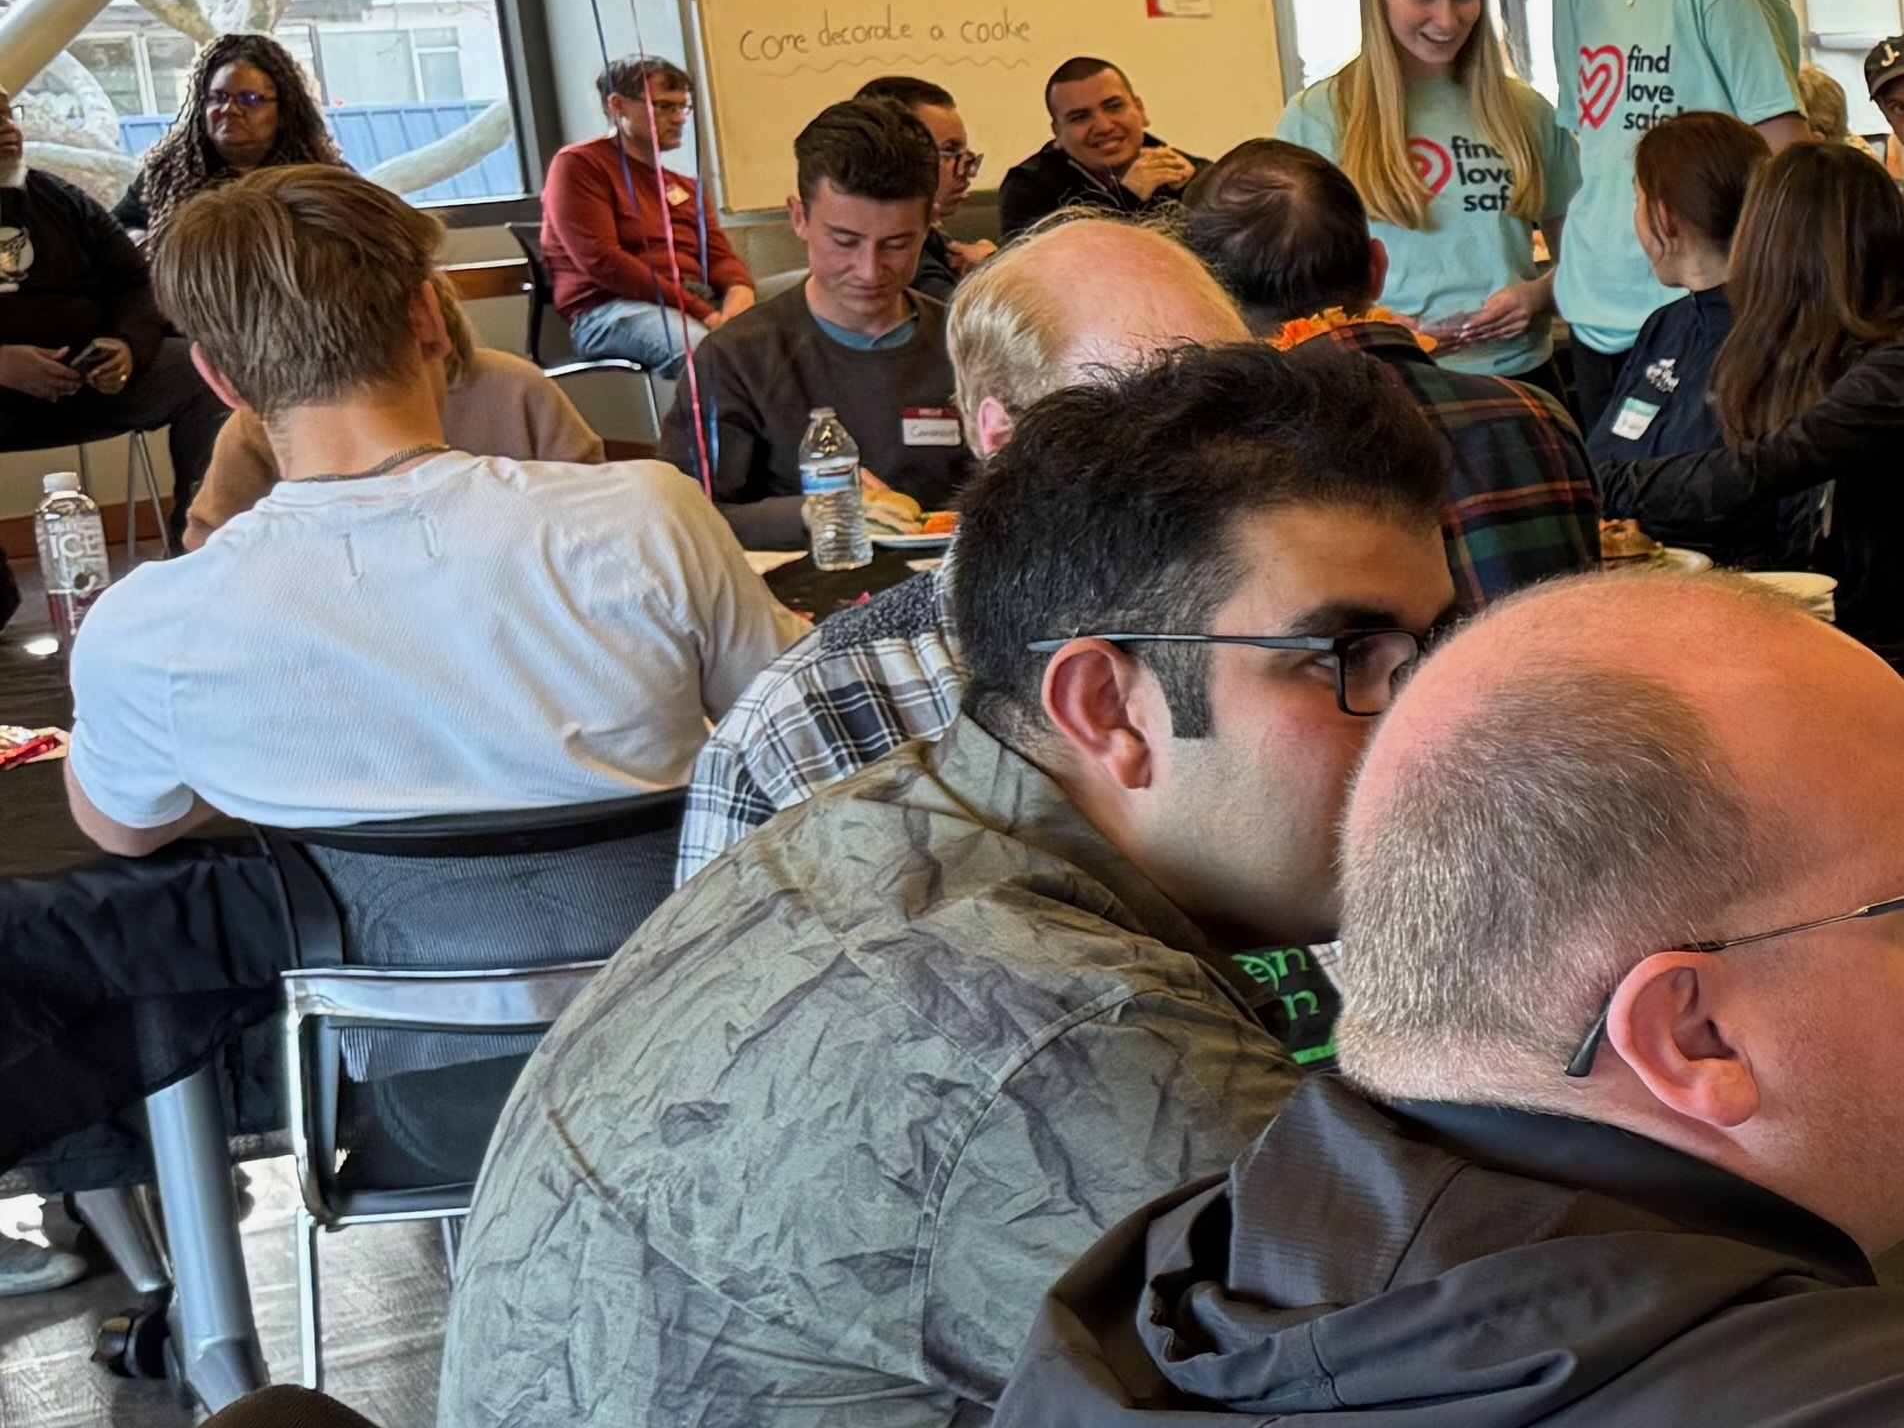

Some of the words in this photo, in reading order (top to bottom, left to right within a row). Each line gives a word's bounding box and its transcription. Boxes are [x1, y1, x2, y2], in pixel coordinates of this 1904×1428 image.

[740, 28, 811, 62] Come
[818, 3, 912, 49] decorate
[929, 23, 947, 42] a
[960, 4, 1031, 45] cookie
[1626, 44, 1671, 73] find
[1626, 78, 1675, 105] love
[49, 532, 104, 559] ICE
